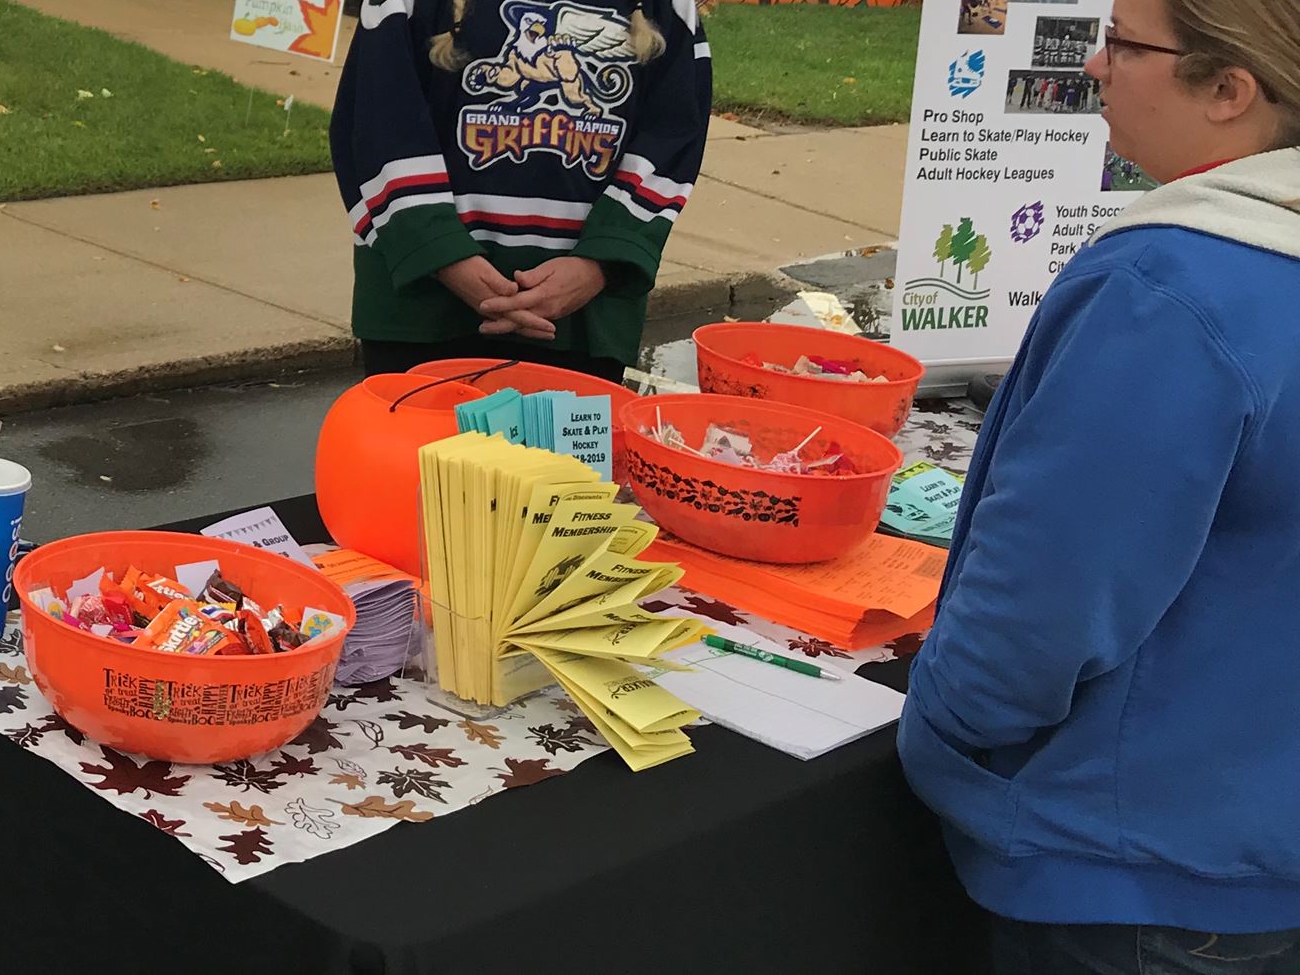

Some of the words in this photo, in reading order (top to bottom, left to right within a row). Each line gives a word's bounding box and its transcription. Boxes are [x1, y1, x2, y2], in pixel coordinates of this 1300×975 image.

[466, 112, 520, 126] GRAND
[575, 120, 619, 135] RAPIDS
[923, 109, 948, 123] Pro
[952, 109, 984, 126] Shop
[921, 128, 959, 142] Learn
[963, 129, 975, 142] to
[978, 128, 1041, 145] Skate/Play
[1045, 128, 1090, 145] Hockey
[919, 148, 961, 161] Public
[964, 148, 998, 161] Skate
[916, 167, 952, 180] Adult
[956, 167, 1000, 182] Hockey
[1004, 167, 1055, 182] Leagues
[1056, 205, 1088, 218] Youth
[1091, 205, 1125, 218] Socc
[1052, 224, 1083, 237] Adult
[1050, 242, 1077, 255] Park
[1048, 261, 1065, 274] Cit
[902, 292, 925, 308] City
[925, 291, 938, 305] of
[1008, 291, 1043, 307] Walk
[901, 306, 990, 331] WALKER
[571, 412, 592, 422] LEARN
[593, 413, 601, 421] TO
[562, 427, 583, 437] SKATE
[584, 426, 591, 435] &
[592, 426, 609, 435] PLAY
[572, 441, 599, 450] HOCKEY
[571, 511, 613, 523] FITNESS
[262, 534, 290, 547] GROUP
